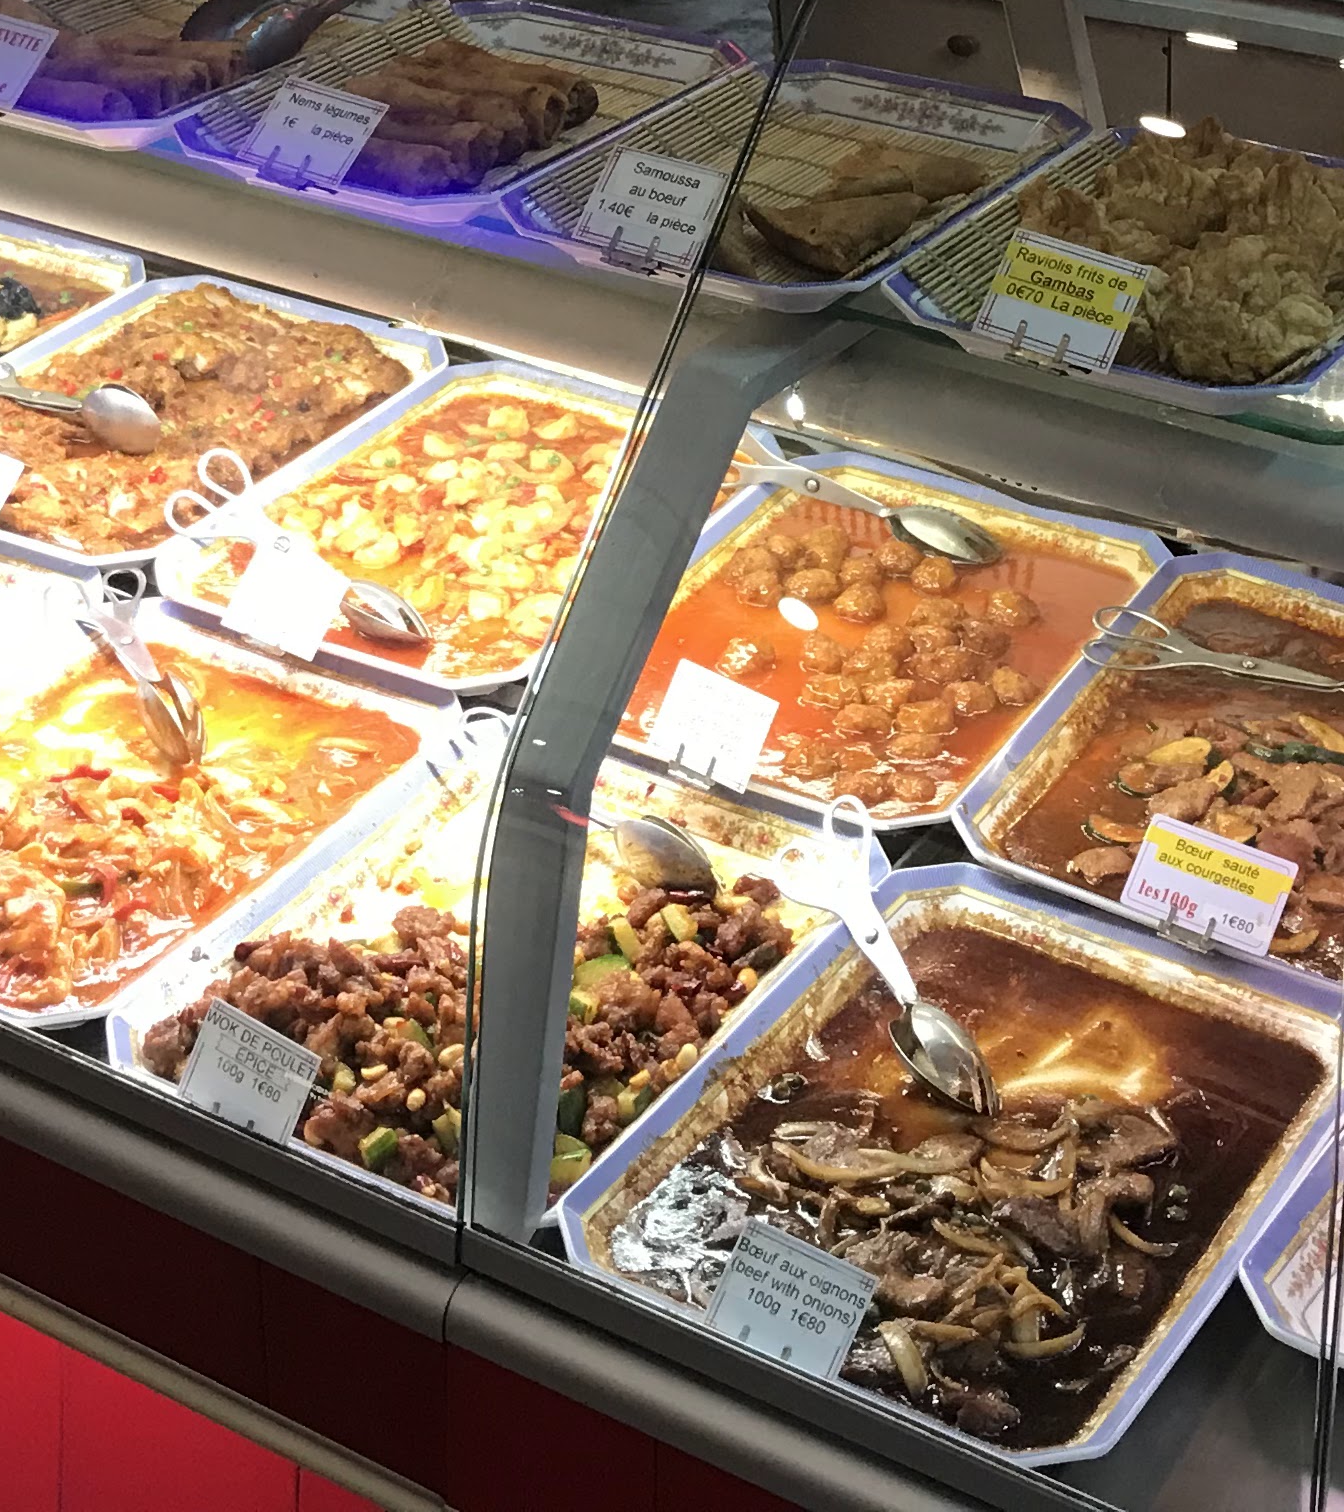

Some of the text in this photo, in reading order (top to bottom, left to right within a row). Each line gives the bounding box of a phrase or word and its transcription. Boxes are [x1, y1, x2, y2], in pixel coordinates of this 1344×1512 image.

[282, 114, 354, 146] 1€ la pièce
[289, 92, 371, 126] Nems légumes
[629, 183, 688, 208] au boeuf
[634, 161, 701, 190] Samoussa
[646, 211, 660, 225] la
[660, 214, 697, 236] pièce
[1016, 246, 1128, 292] Raviolis frits de
[1030, 270, 1095, 300] Gambas
[1006, 282, 1114, 326] 0€70 La pièce
[1159, 849, 1256, 897] aux courgettes
[1175, 838, 1260, 880] Bœuf sauté
[1220, 914, 1255, 935] 1€80
[205, 1007, 316, 1081] WOK DE POULET
[215, 1056, 282, 1105] 100g 1€80
[731, 1257, 858, 1329] (beef with onions)
[737, 1237, 867, 1310] Bœuf aux oignons
[746, 1286, 828, 1336] 100g 1€80
